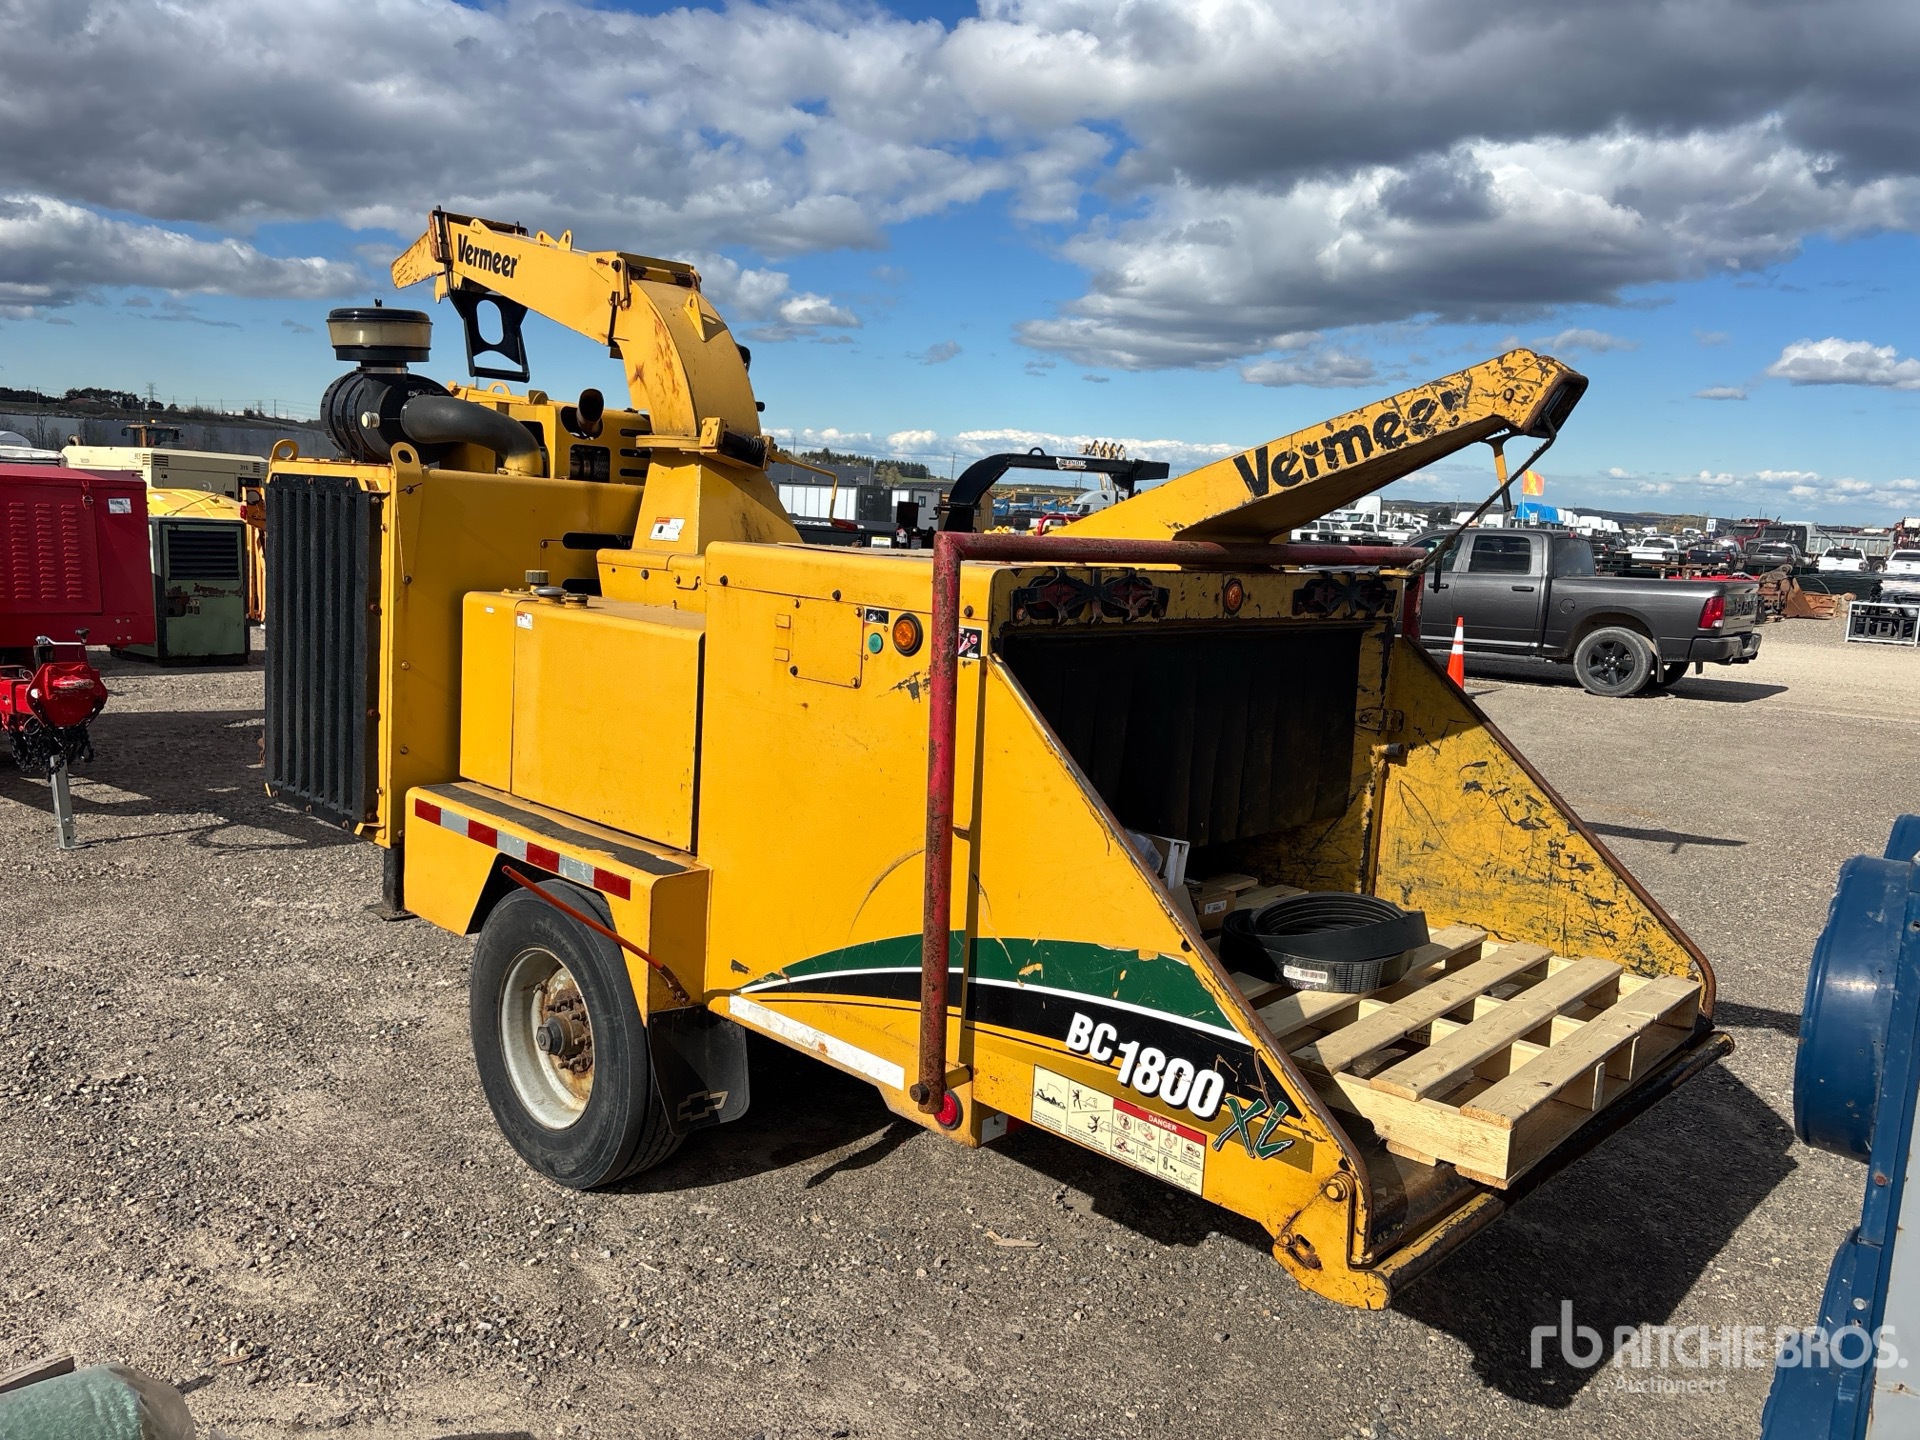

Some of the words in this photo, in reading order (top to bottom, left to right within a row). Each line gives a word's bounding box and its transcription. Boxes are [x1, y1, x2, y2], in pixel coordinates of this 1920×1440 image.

[458, 233, 518, 278] Vermeer
[1065, 1012, 1225, 1120] BC1800
[1212, 1098, 1296, 1160] XL
[1148, 1114, 1178, 1133] DANGER
